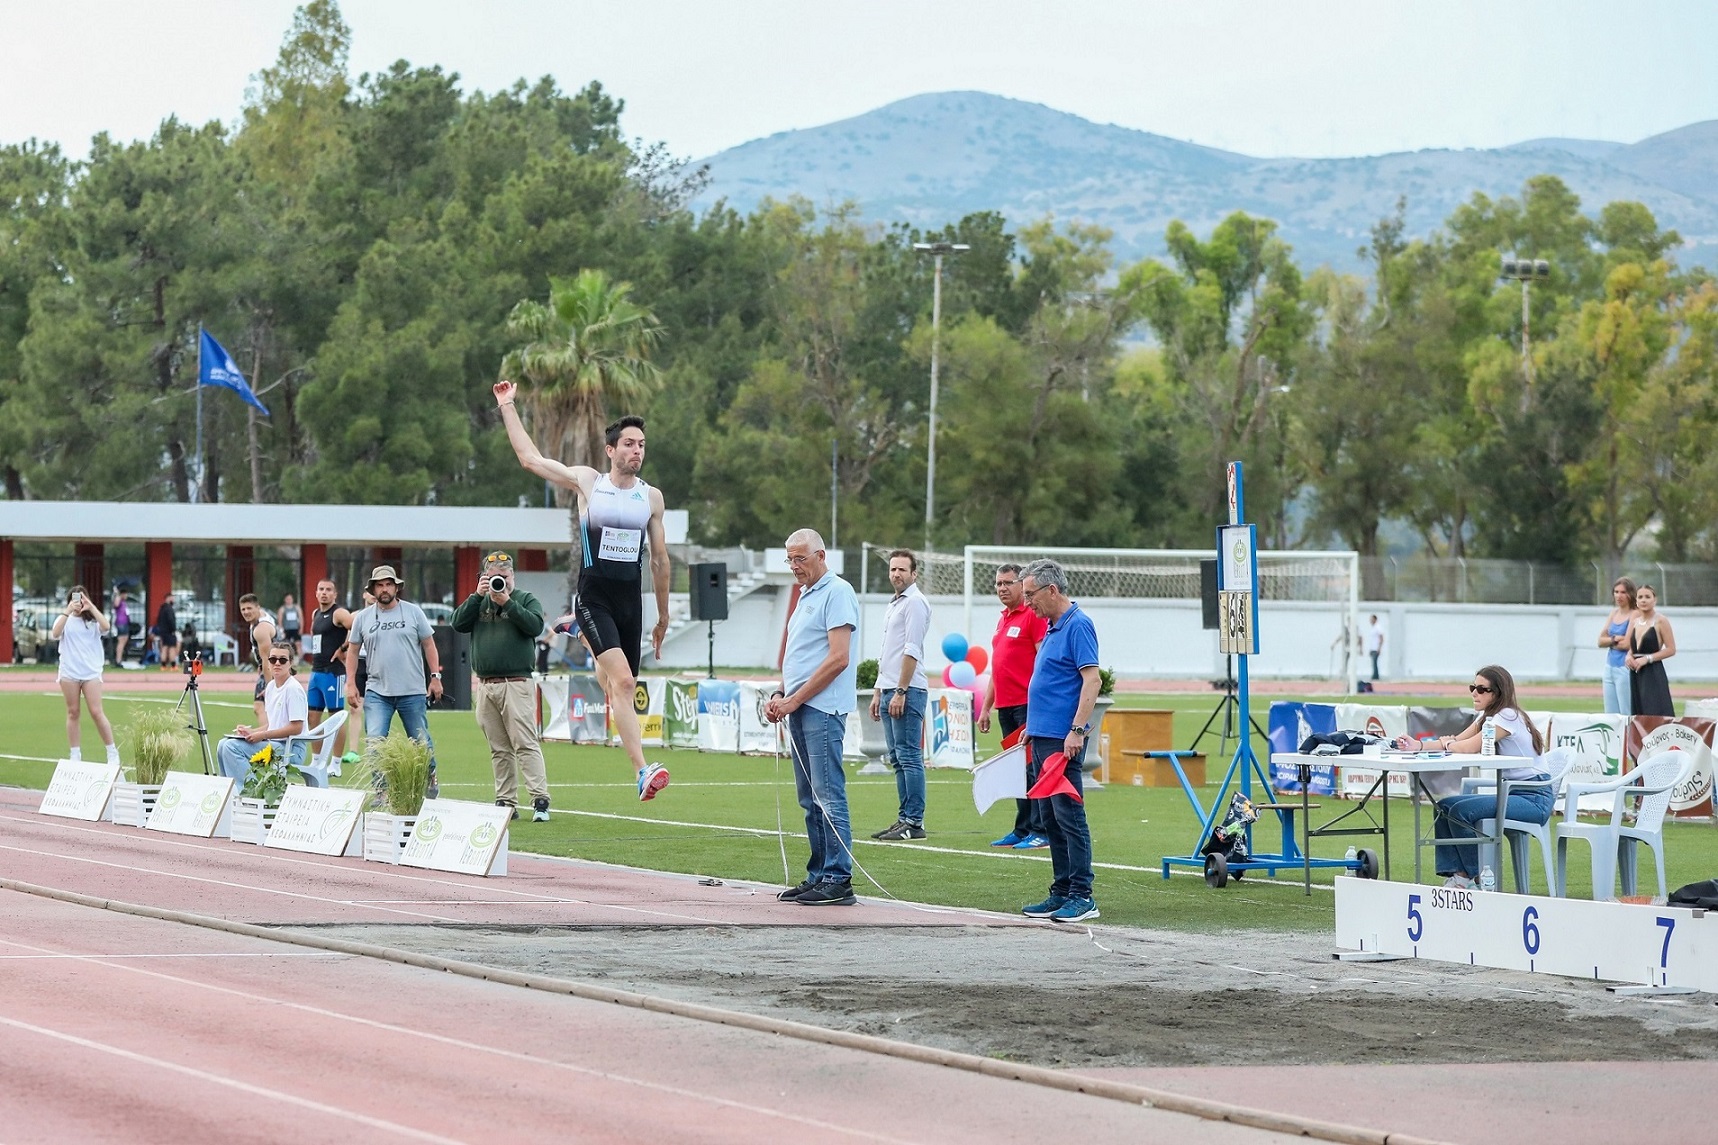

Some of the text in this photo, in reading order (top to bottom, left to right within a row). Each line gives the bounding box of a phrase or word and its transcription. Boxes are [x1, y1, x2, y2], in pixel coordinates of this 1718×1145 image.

[602, 544, 639, 553] TENTOGLOU
[381, 621, 406, 631] asics
[1644, 732, 1670, 751] ούρνος
[1675, 728, 1698, 744] Bakery
[283, 796, 332, 812] ΓΥΜΝΑΣΤΙΚΗ
[276, 811, 311, 827] ΕΤΑΙΡΕΙΑ
[269, 828, 316, 843] ΚΕΦΑΛΛΗΝΙΑΣ
[1431, 888, 1474, 912] 3STARS
[1407, 894, 1423, 942] 5
[1522, 905, 1541, 956] 6
[1655, 916, 1676, 969] 7
